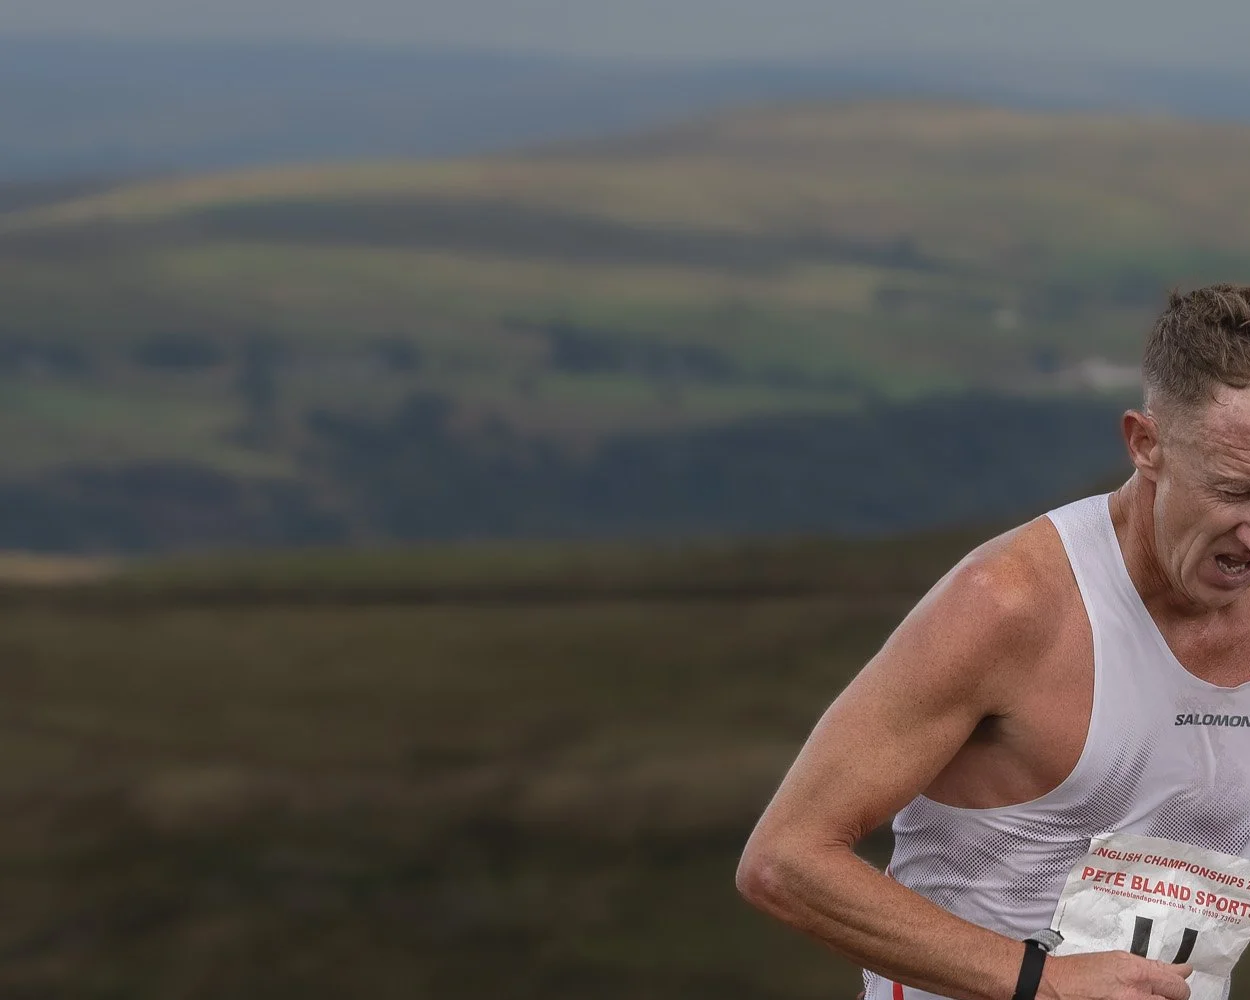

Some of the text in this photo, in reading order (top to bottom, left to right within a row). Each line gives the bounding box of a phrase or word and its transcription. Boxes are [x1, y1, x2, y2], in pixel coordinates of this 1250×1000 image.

[1081, 866, 1127, 888] PETE
[1130, 875, 1191, 901] BLAND
[1143, 854, 1245, 888] CHAMPIONSHIPS
[1093, 884, 1186, 910] www.peteblandsports.co.uk
[1188, 905, 1198, 914] Tel
[1201, 908, 1219, 919] 01539
